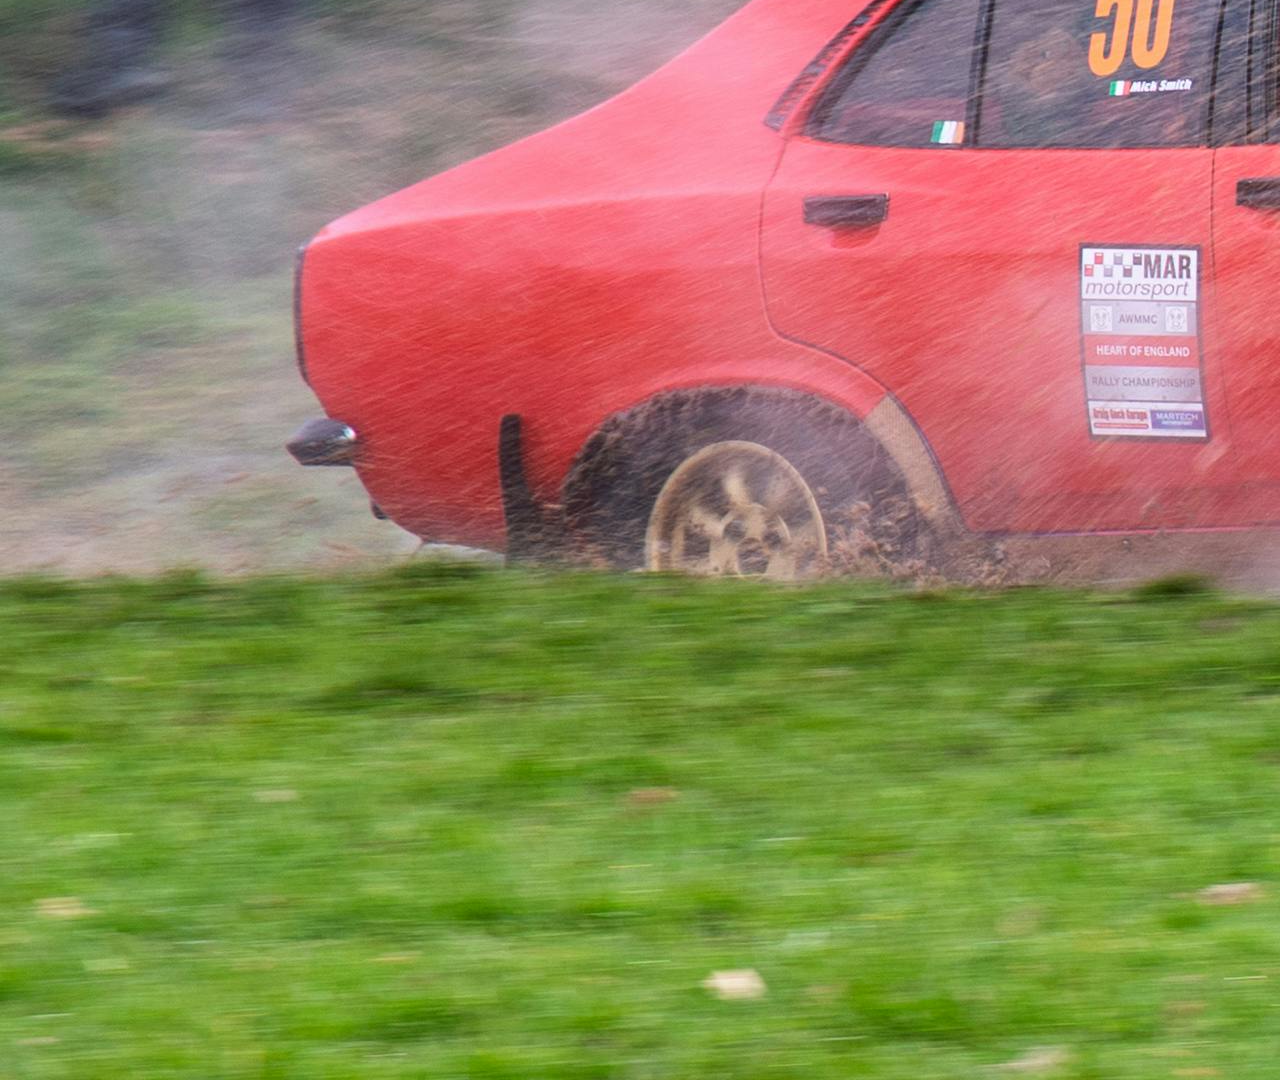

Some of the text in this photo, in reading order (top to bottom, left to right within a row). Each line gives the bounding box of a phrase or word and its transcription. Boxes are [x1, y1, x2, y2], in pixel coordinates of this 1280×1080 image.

[1158, 79, 1192, 92] Smith
[1144, 254, 1191, 279] MAR
[1085, 281, 1189, 299] motorsport
[1118, 314, 1158, 325] AWMMC
[1096, 345, 1190, 357] HEART OF ENGLAND
[1092, 376, 1196, 388] RALLY CHAMPIONSHIP
